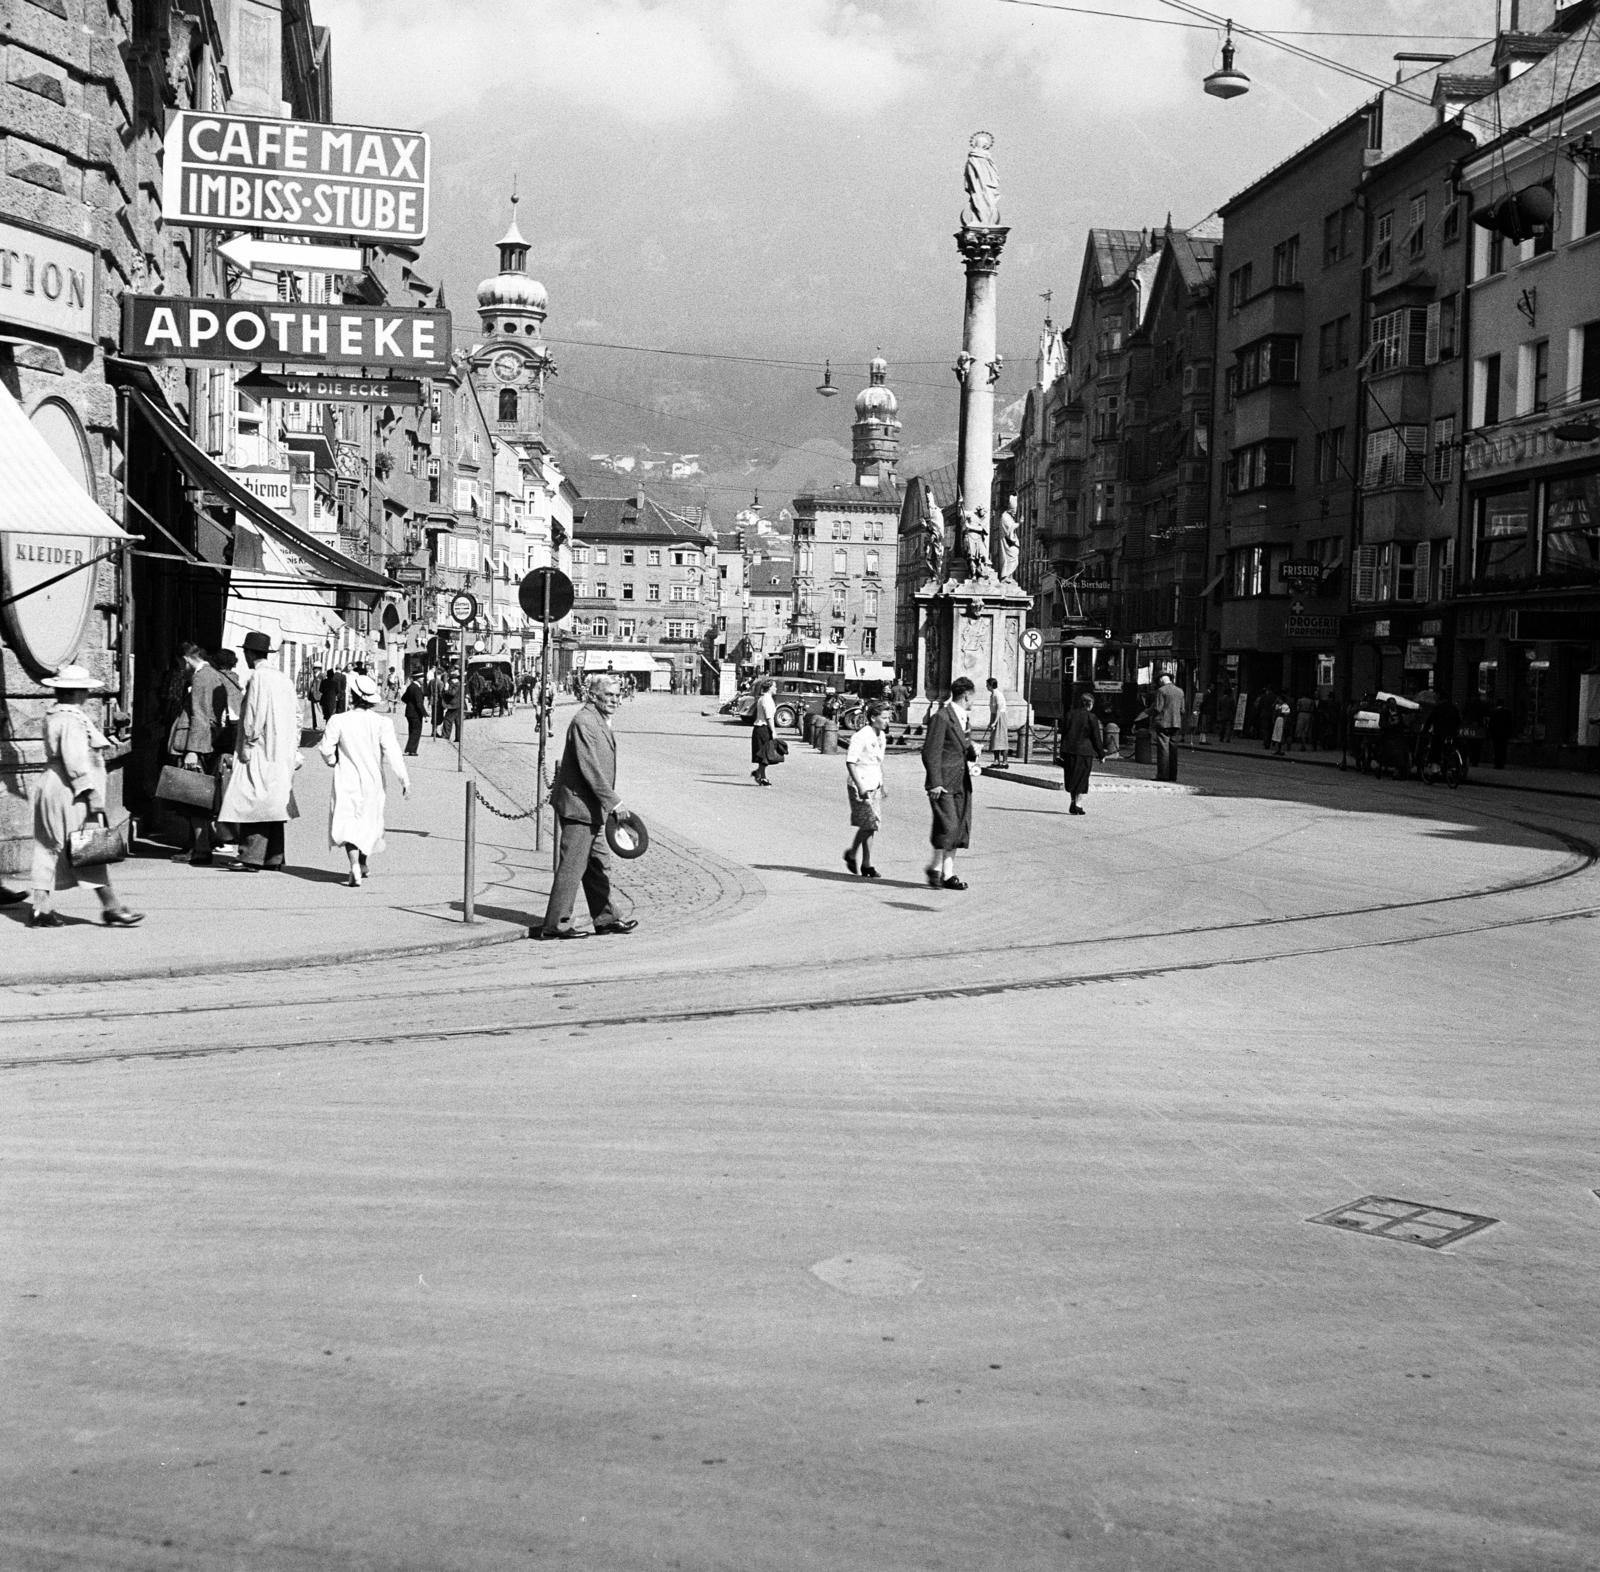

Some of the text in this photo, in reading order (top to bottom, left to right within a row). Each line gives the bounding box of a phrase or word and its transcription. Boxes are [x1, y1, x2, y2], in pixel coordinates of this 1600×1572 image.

[321, 130, 419, 180] MAX
[143, 306, 435, 359] APOTHEKE
[287, 380, 390, 397] UM DIE ECKE
[16, 543, 83, 565] KLEIDER
[1282, 565, 1320, 577] FRISEUR
[1105, 629, 1112, 639] 3
